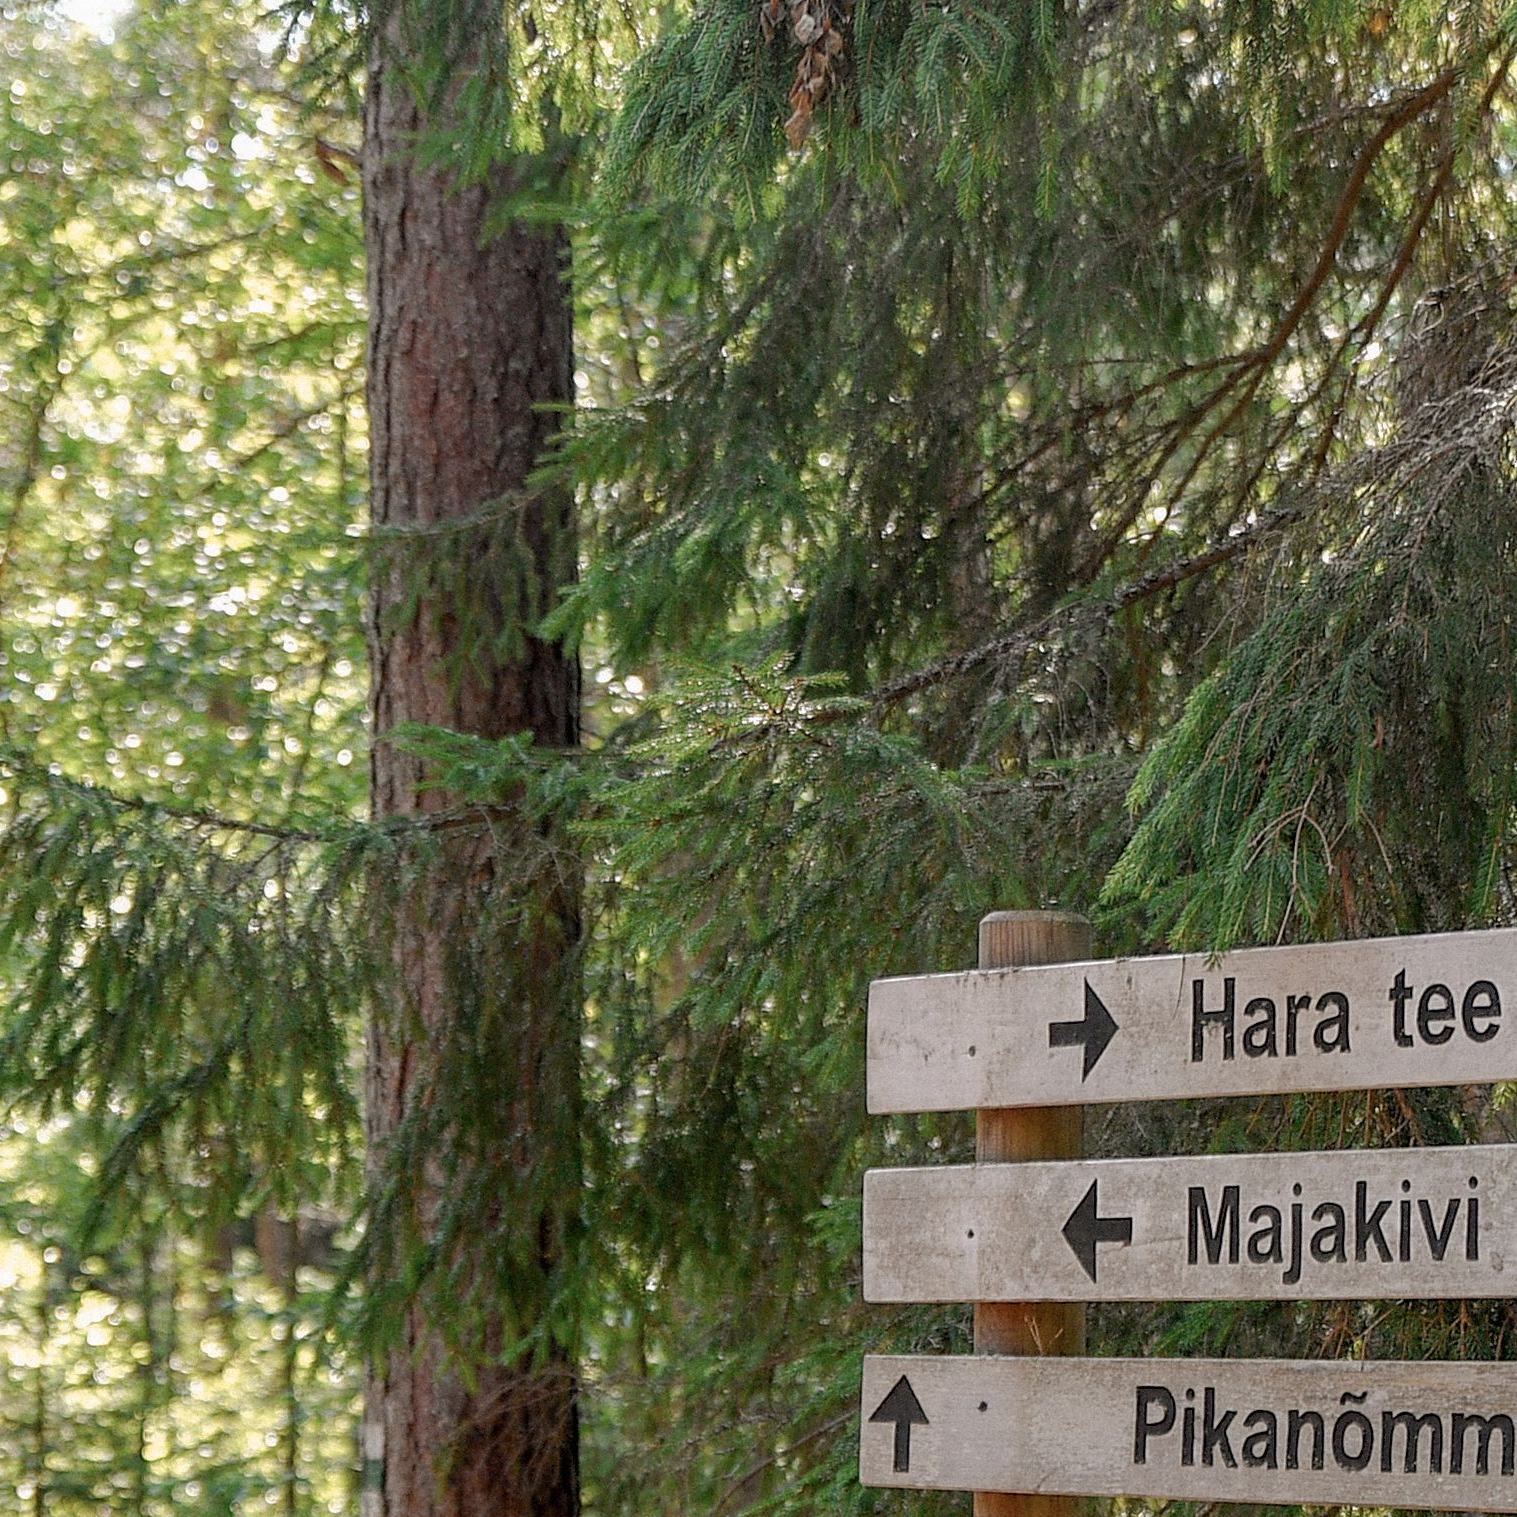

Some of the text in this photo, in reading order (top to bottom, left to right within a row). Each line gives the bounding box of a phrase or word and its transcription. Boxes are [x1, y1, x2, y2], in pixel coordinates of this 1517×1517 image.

[1190, 976, 1351, 1063] Hara
[1389, 967, 1502, 1048] tee
[1186, 1175, 1481, 1285] Majakivi
